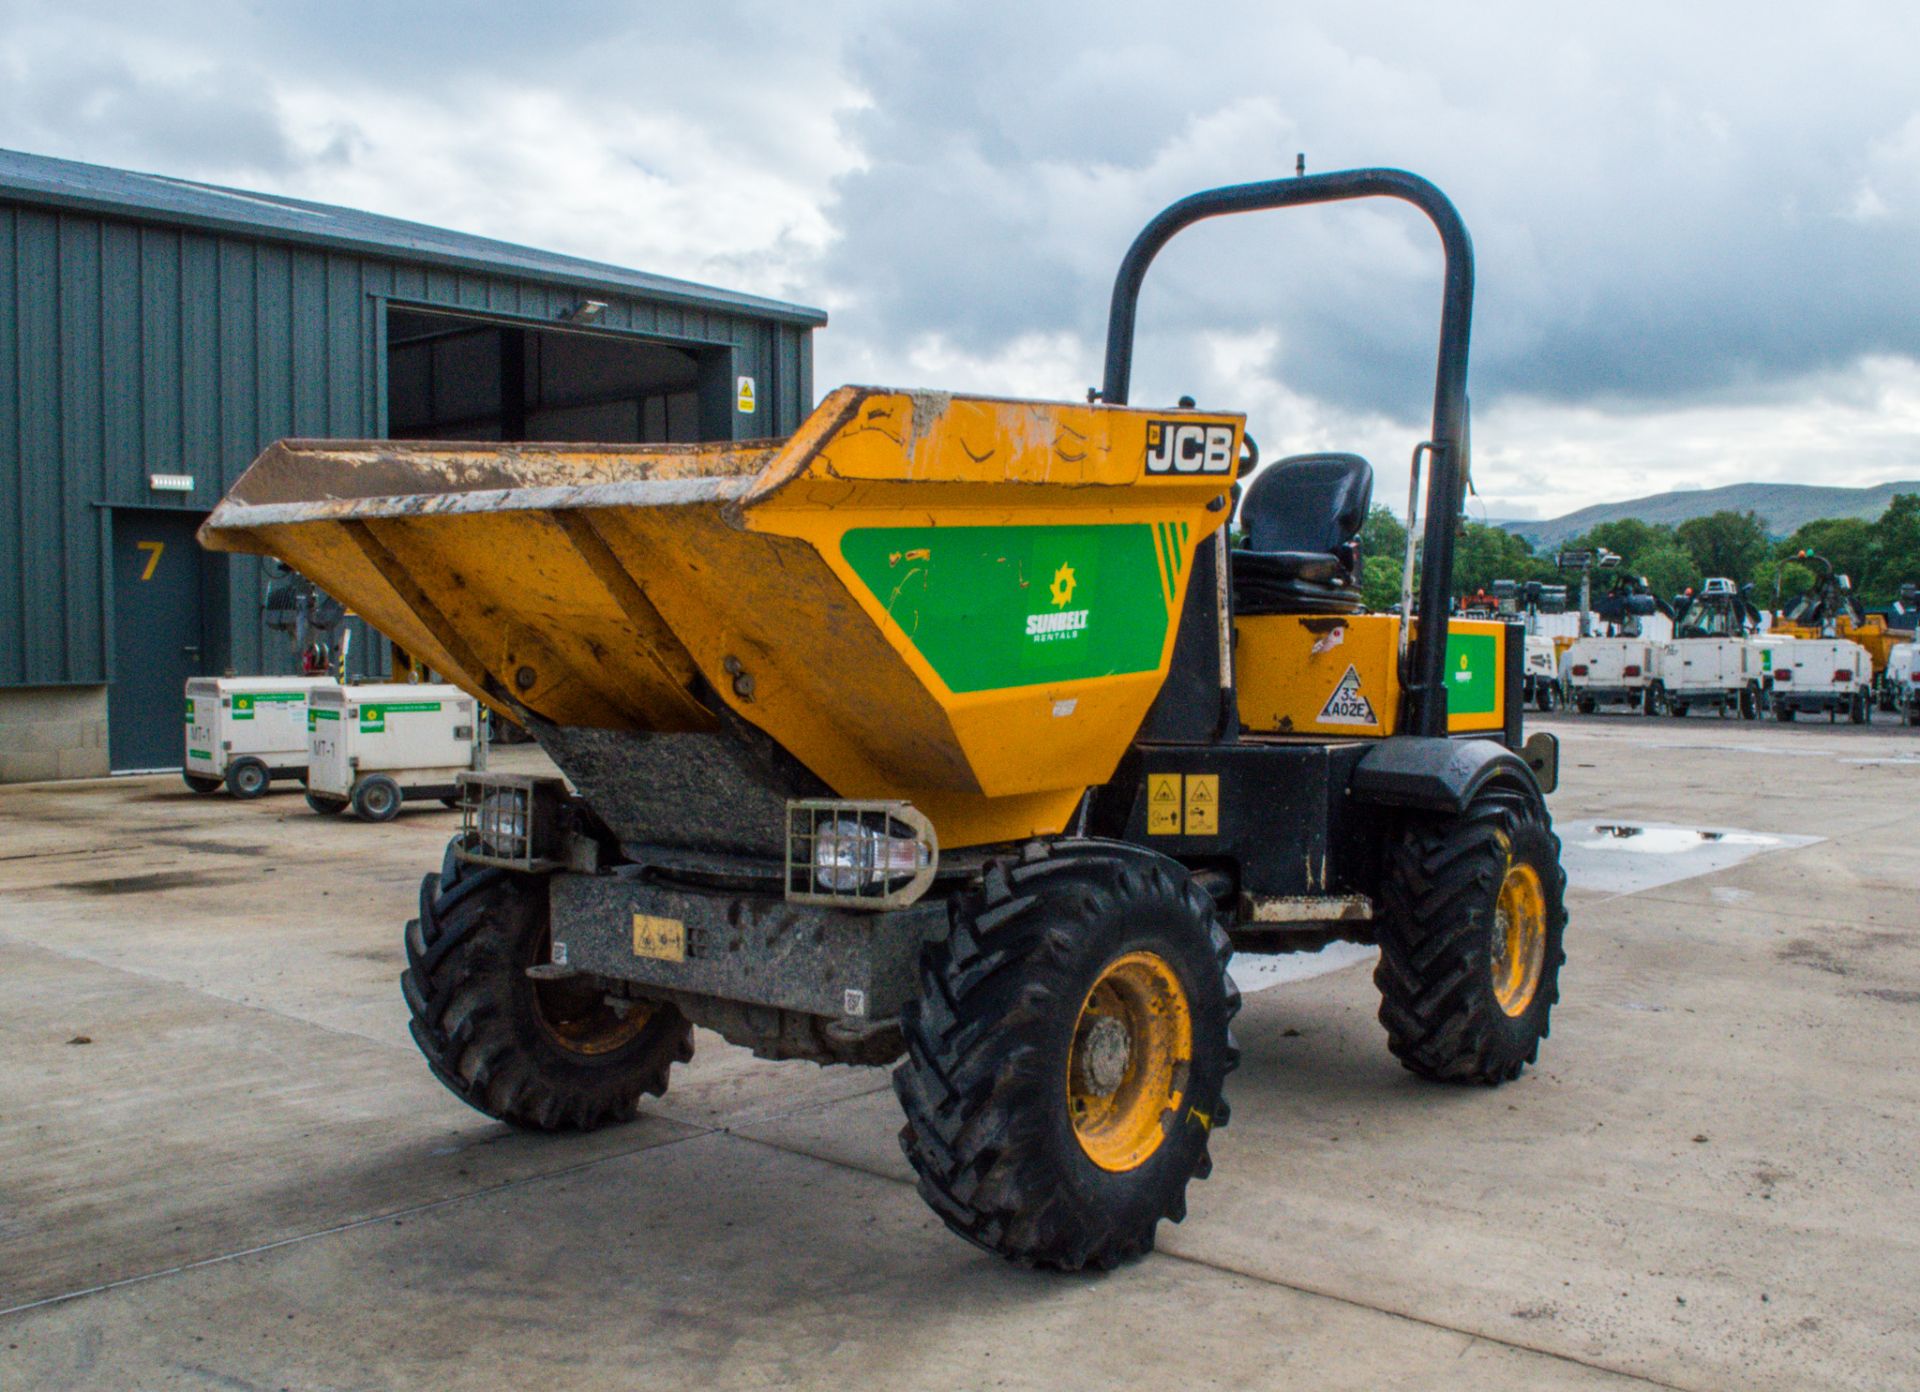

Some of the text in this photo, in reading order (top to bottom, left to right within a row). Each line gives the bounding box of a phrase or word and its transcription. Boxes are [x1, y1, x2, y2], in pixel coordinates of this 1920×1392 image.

[1147, 424, 1233, 472] JCB
[137, 541, 165, 580] 7
[1025, 609, 1089, 635] SUNBELT
[1033, 630, 1078, 642] RENTALS
[1332, 702, 1365, 717] A02E
